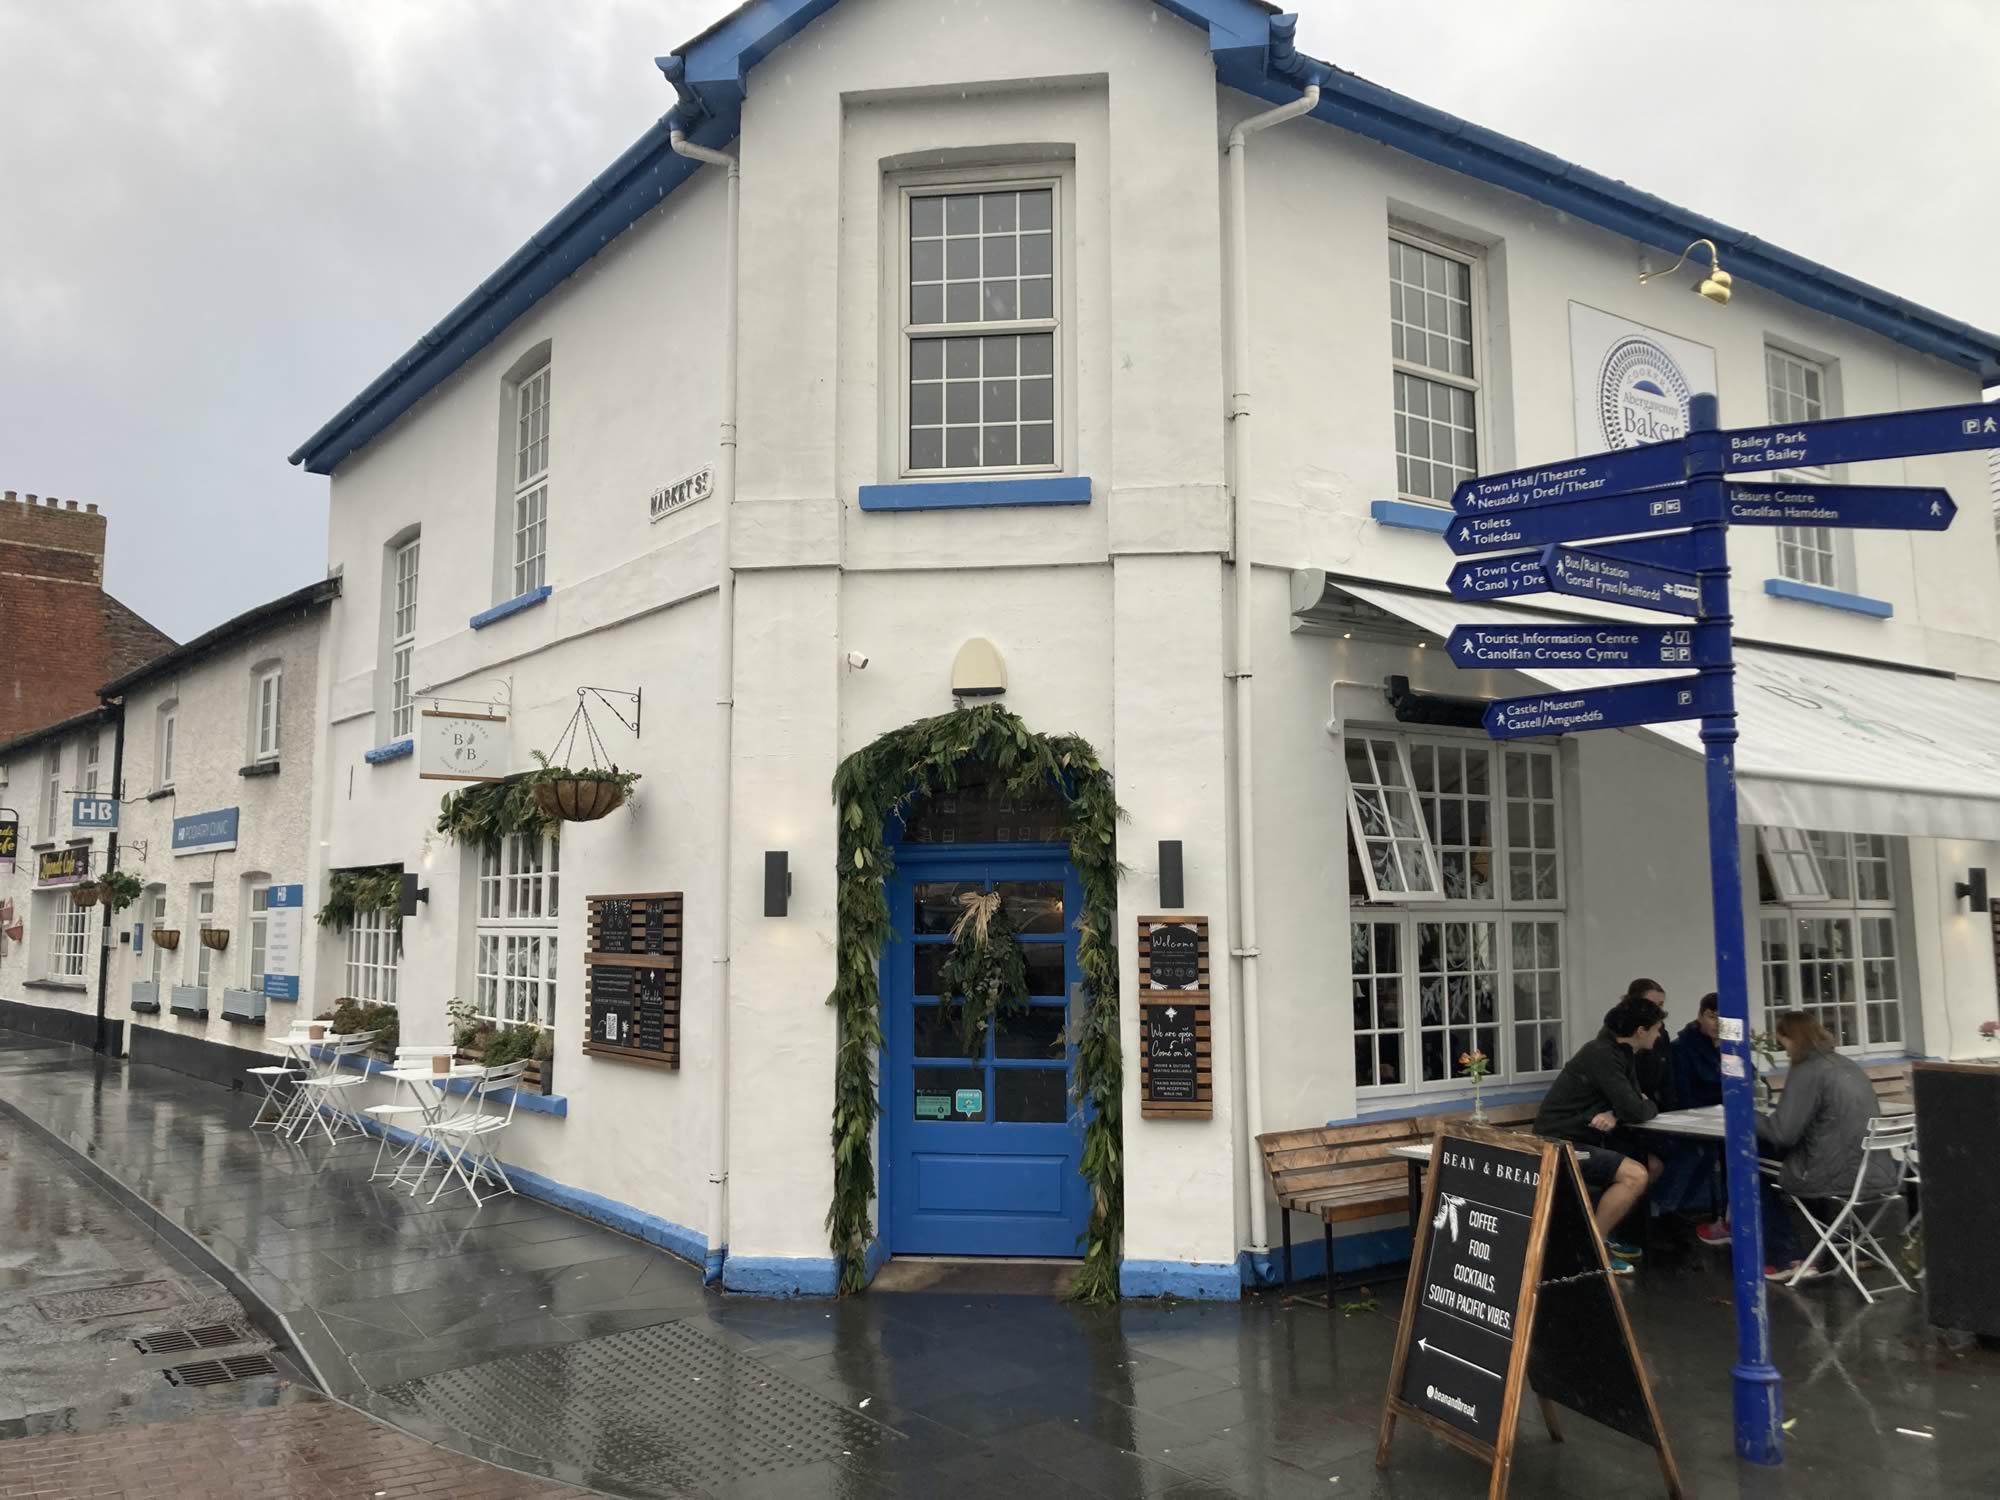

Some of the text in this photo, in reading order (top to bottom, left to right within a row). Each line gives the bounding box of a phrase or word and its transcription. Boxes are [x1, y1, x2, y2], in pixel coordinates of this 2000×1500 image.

[1731, 431, 1807, 449] Bailey Park
[1732, 448, 1806, 464] Parc Bailey
[1477, 467, 1587, 495] Town Hall/Theatre
[650, 479, 693, 517] MARKET
[1477, 478, 1607, 509] Neuadd y Dref/Theatr
[1730, 490, 1815, 503] Leisure Centre
[1731, 505, 1838, 519] Canolfan Hamdden
[1472, 519, 1511, 531] Toilets
[1472, 532, 1521, 545] Toiledau
[1475, 561, 1540, 578] Town Cent
[1564, 555, 1629, 579] Bus/Rail Station
[1475, 575, 1545, 592] Canol y Dre
[1565, 572, 1595, 588] Gorsaf
[1475, 632, 1639, 645] Tourist Information Centre
[1476, 648, 1629, 662] Canolfan Croeso Cymru
[1506, 699, 1585, 716] Castle/Museum
[1507, 711, 1604, 730] Castell/Amgueddfa
[454, 733, 464, 745] B
[467, 749, 477, 761] B
[79, 801, 112, 820] HB
[1152, 934, 1194, 949] Welcome
[1151, 1023, 1163, 1038] We
[1178, 1031, 1195, 1044] open
[1152, 1040, 1172, 1057] Come
[1184, 1048, 1193, 1057] in
[1443, 1151, 1540, 1186] BEAN & BREAD
[1468, 1210, 1499, 1234] COFFEE.
[1468, 1239, 1490, 1260] FOOD.
[1453, 1263, 1496, 1293] COCKTAILS.
[1428, 1283, 1511, 1330] SOUTH PACIFIC VIBES.
